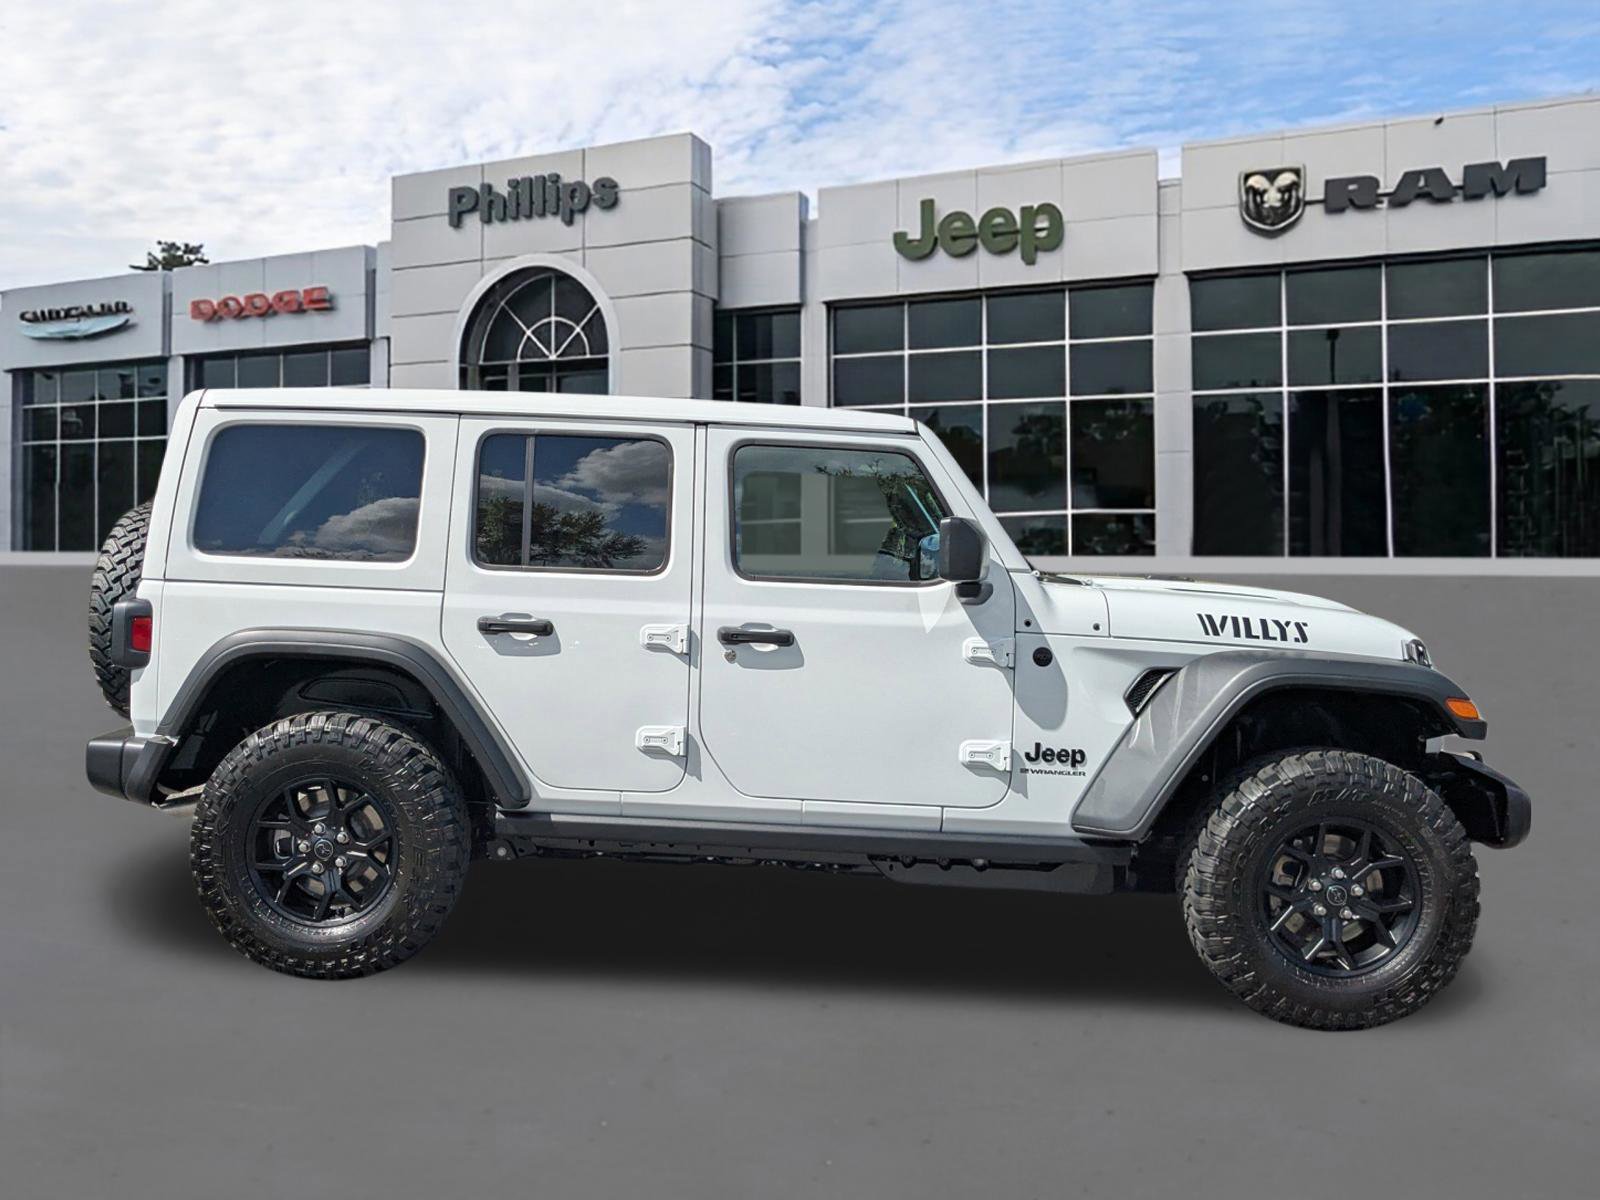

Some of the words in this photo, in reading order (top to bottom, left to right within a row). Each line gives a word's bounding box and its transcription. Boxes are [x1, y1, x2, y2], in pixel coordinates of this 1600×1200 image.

[449, 173, 619, 229] Phillips
[1324, 156, 1547, 214] RAM
[893, 198, 1064, 266] Jeep
[190, 286, 332, 322] DODGE
[1197, 613, 1309, 643] WILLYS
[1025, 742, 1086, 768] Jeep
[1031, 768, 1086, 776] WRANGLER
